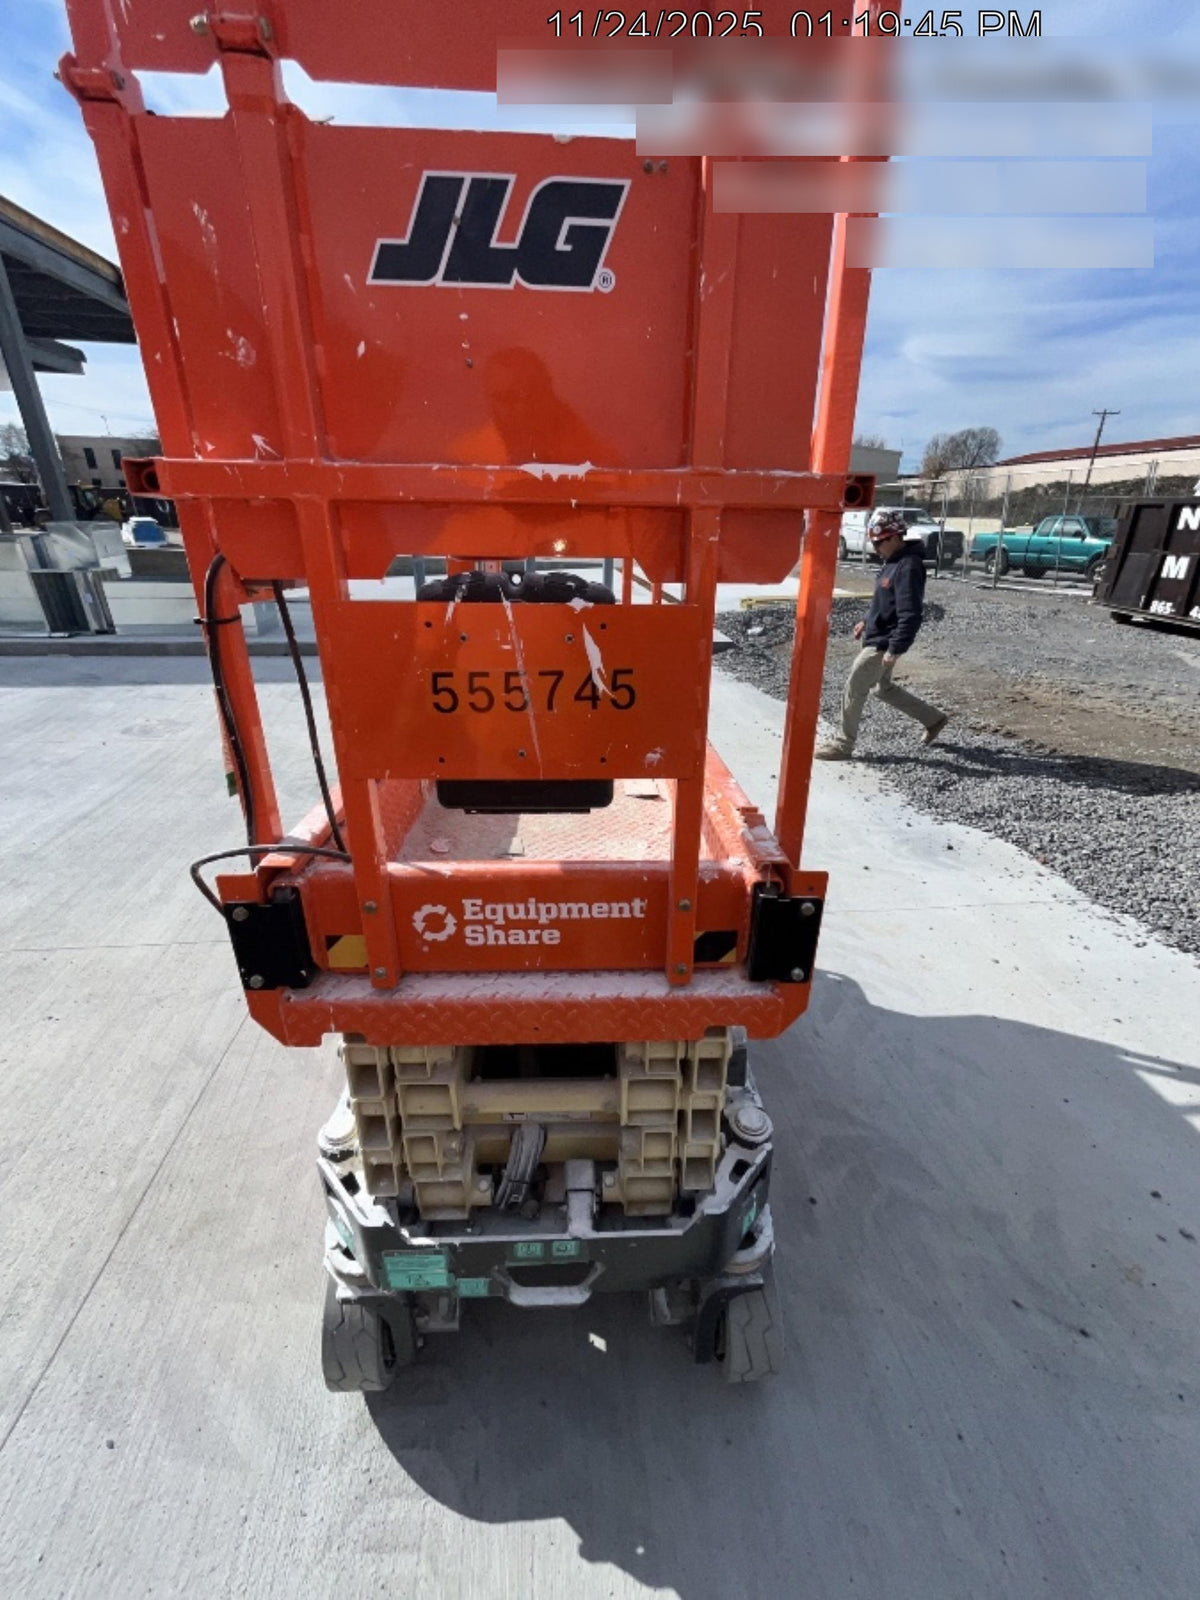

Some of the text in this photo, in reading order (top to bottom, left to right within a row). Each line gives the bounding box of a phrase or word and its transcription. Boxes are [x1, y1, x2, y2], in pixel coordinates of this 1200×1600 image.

[366, 170, 632, 292] JLG
[431, 668, 637, 714] 555745
[462, 897, 647, 924] Equipment
[464, 924, 561, 947] Share
